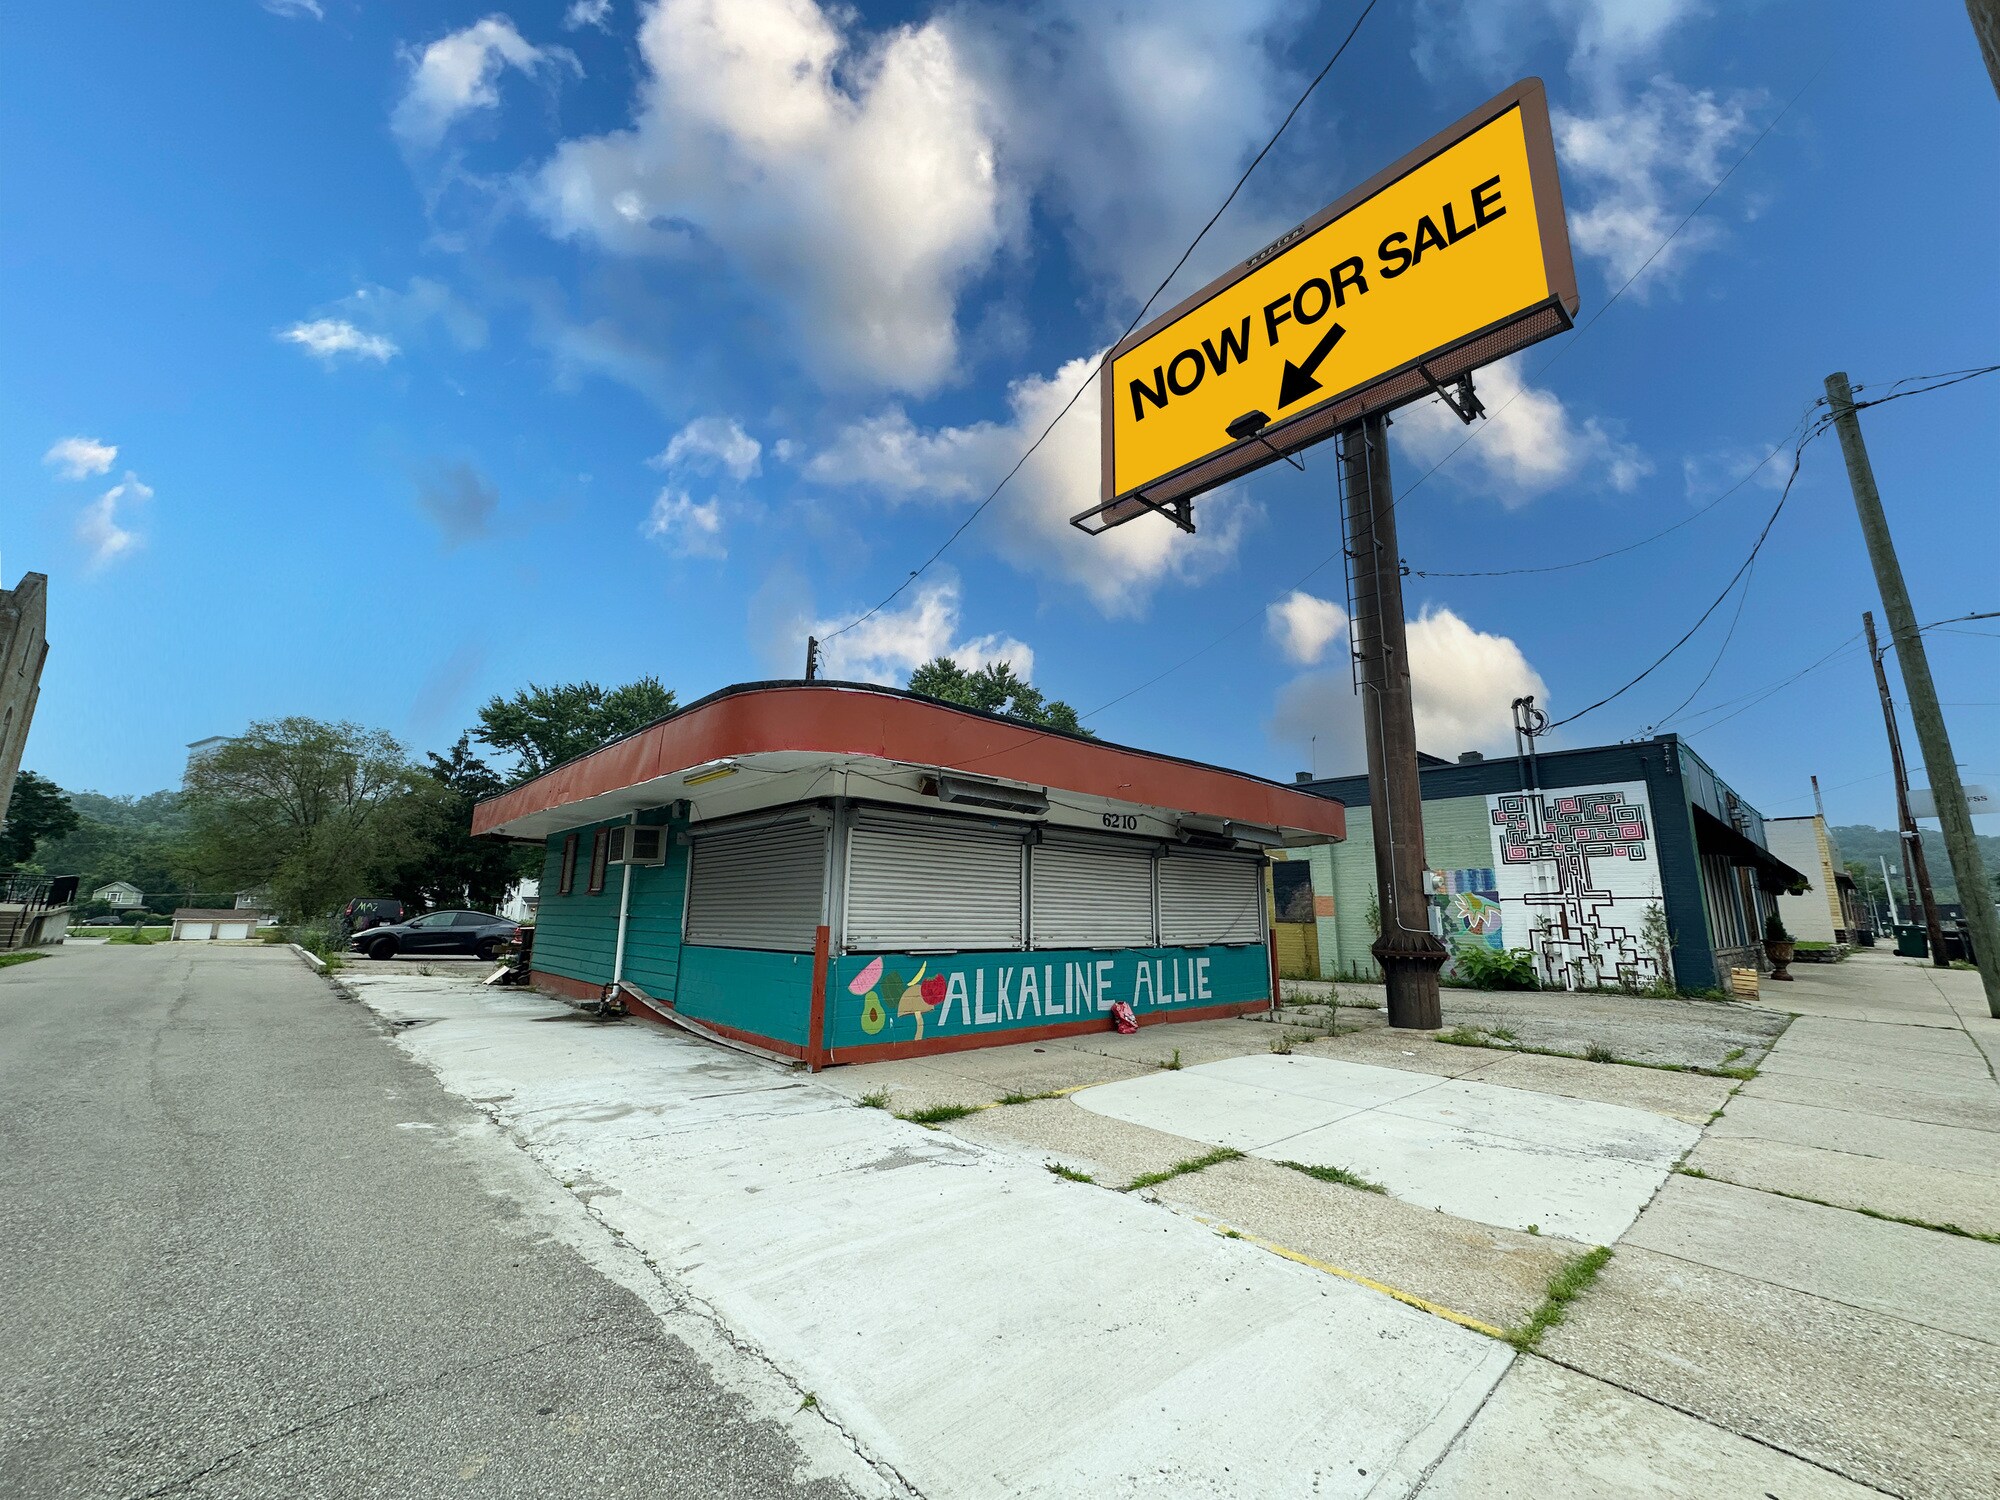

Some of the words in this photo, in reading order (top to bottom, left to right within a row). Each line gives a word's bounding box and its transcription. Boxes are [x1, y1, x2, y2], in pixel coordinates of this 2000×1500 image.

[1129, 315, 1251, 422] NOW
[1263, 256, 1370, 347] FOR
[1377, 174, 1507, 279] SALE
[1103, 813, 1137, 830] 6210
[937, 960, 1116, 1026] ALKALINE
[1133, 957, 1212, 1007] ALLIE
